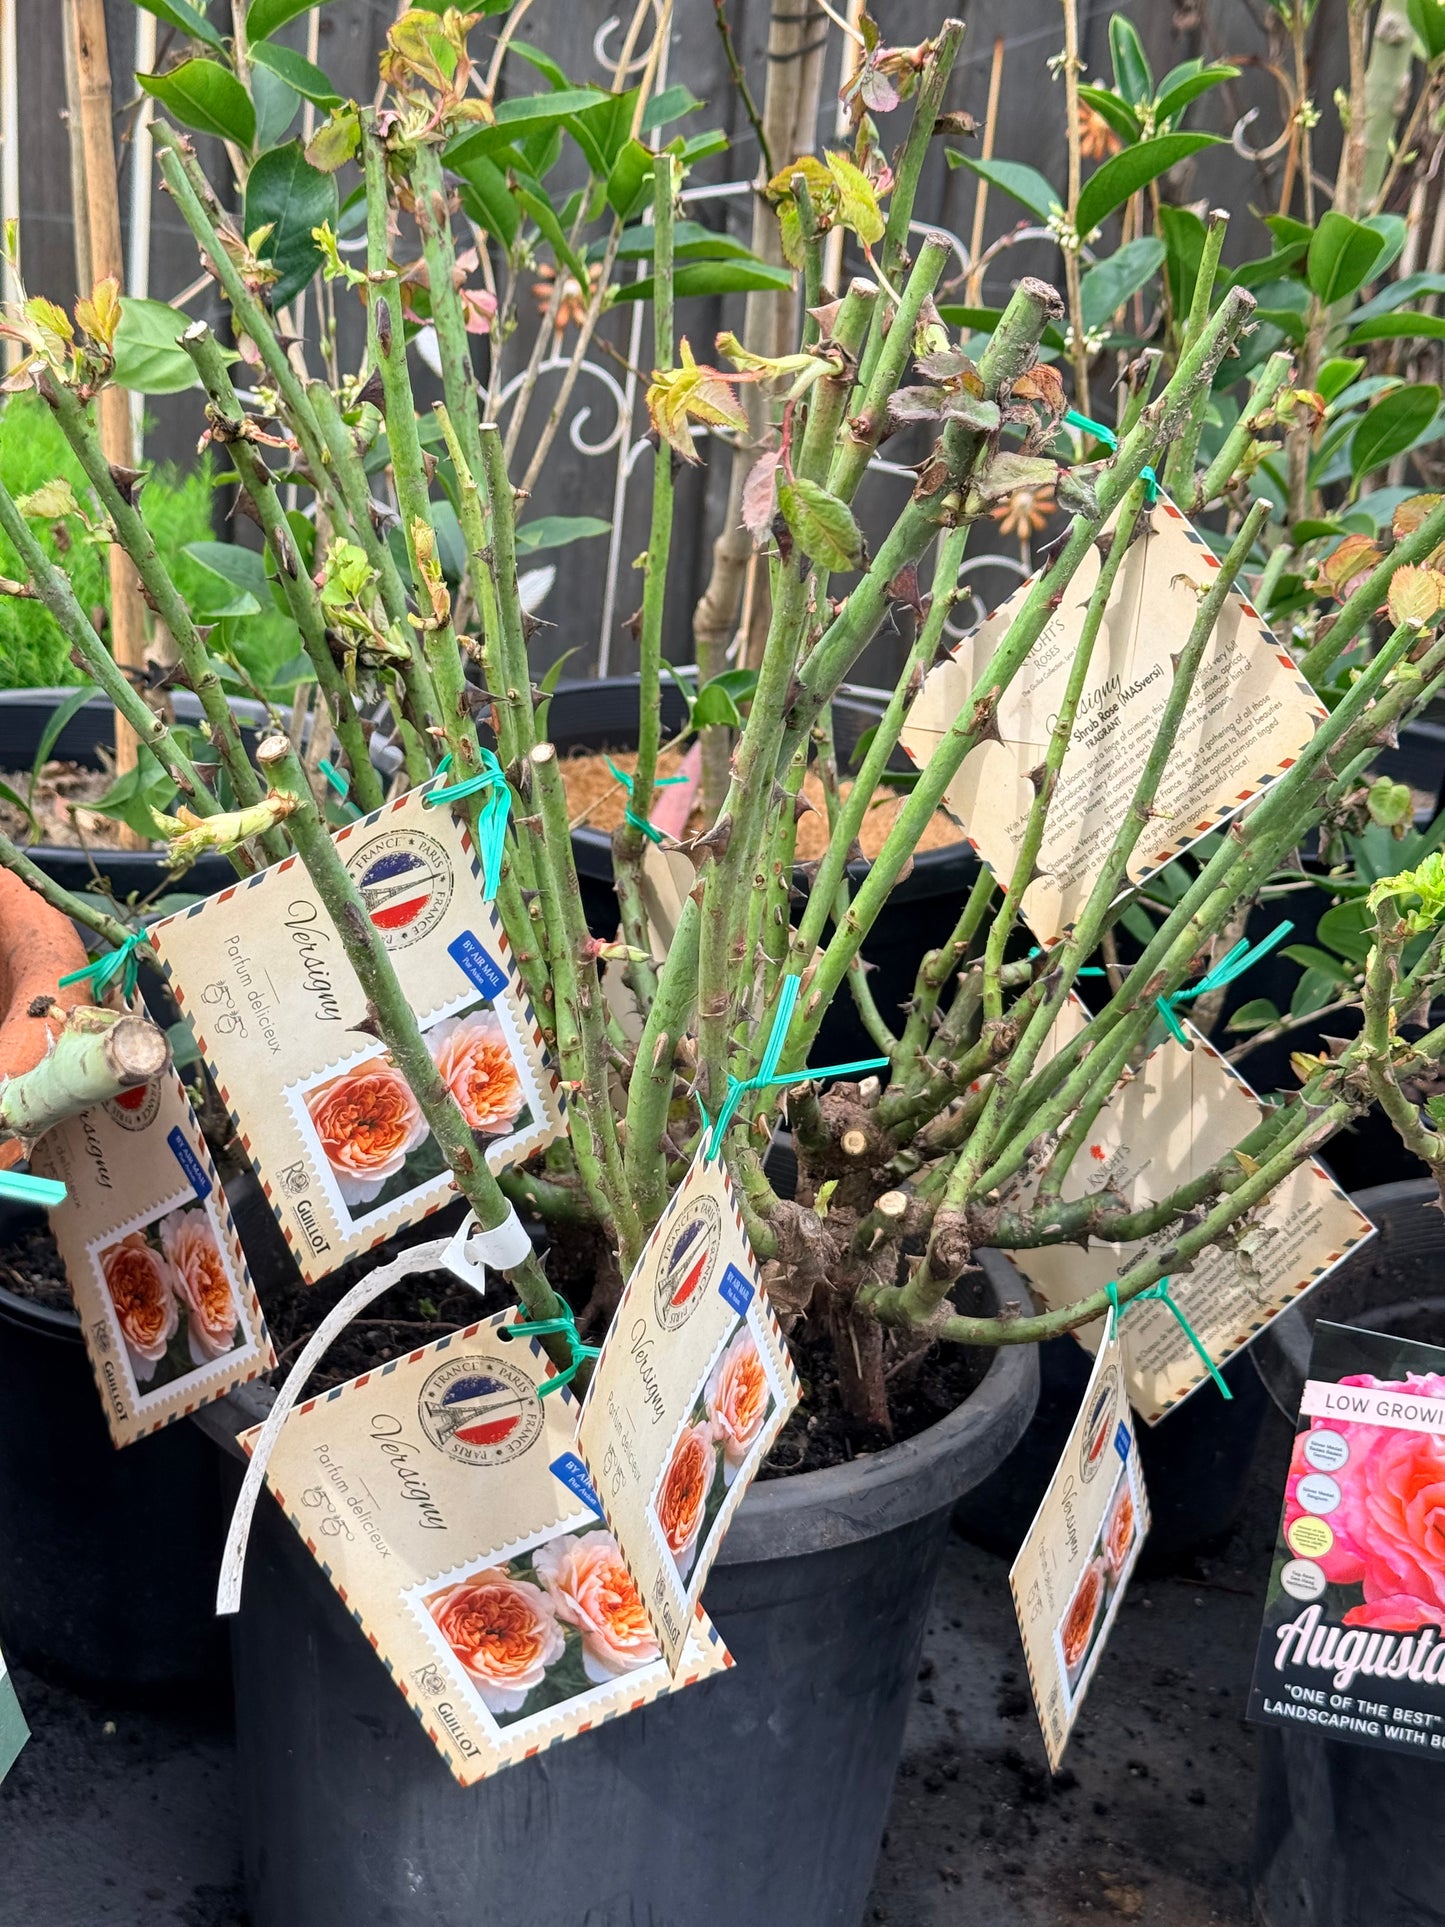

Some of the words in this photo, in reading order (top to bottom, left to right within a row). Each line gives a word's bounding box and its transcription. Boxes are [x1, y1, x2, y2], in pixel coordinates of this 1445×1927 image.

[1033, 644, 1060, 670] ROSES
[1062, 766, 1087, 786] blooms
[1085, 755, 1099, 769] and
[1097, 751, 1105, 759] a
[1102, 739, 1120, 754] tinge
[1119, 730, 1127, 742] of
[1126, 714, 1153, 736] crimson,
[1150, 702, 1164, 715] this
[1212, 650, 1228, 665] very
[1224, 639, 1238, 653] full
[1072, 718, 1099, 742] Shrub
[1096, 702, 1119, 722] Rose
[1116, 663, 1164, 706] (MASversi)
[1047, 803, 1059, 814] are
[1058, 779, 1087, 808] produced
[1084, 775, 1094, 783] in
[1092, 758, 1115, 778] clusters
[1113, 750, 1123, 761] of
[1120, 745, 1128, 754] 2
[1127, 740, 1136, 750] or
[1135, 728, 1153, 744] more.
[1192, 685, 1201, 697] of
[1201, 673, 1221, 690] anise,
[1219, 652, 1246, 675] apricot,
[1055, 808, 1069, 823] and
[1067, 794, 1088, 812] vanilla
[1092, 778, 1108, 792] very
[1106, 761, 1128, 781] distinct
[1125, 756, 1135, 765] in
[1134, 742, 1151, 759] each
[1196, 676, 1229, 709] occasional
[1228, 667, 1245, 681] hint
[1243, 659, 1252, 671] of
[1084, 715, 1121, 749] FRAGRANT
[1046, 827, 1066, 846] peach
[1083, 795, 1106, 814] flowers
[1103, 789, 1112, 797] in
[1111, 765, 1143, 792] continuous
[1195, 713, 1208, 725] the
[1207, 695, 1233, 716] season,
[1064, 852, 1088, 871] flowers
[1086, 841, 1101, 855] and
[1159, 779, 1183, 798] France.
[1184, 762, 1202, 778] Such
[1201, 742, 1229, 766] devotion
[1227, 736, 1237, 745] to
[1234, 719, 1254, 739] floral
[1251, 700, 1283, 725] beauties
[1070, 844, 1080, 854] de
[1077, 825, 1105, 847] Versigny
[1174, 756, 1192, 771] there
[1197, 745, 1205, 754] a
[1204, 722, 1236, 751] gathering
[1234, 712, 1243, 725] of
[1242, 705, 1253, 719] all
[1250, 694, 1270, 711] those
[1056, 874, 1076, 893] should
[1075, 863, 1091, 879] merit
[1159, 801, 1173, 812] this
[1172, 772, 1209, 804] semi-double
[1208, 753, 1233, 776] apricot
[1231, 735, 1257, 758] crimson
[1256, 716, 1279, 738] tinged
[1103, 792, 1129, 814] creating
[1127, 787, 1134, 795] a
[1141, 832, 1151, 841] to
[1150, 822, 1165, 837] give
[1180, 802, 1190, 811] to
[1188, 794, 1202, 806] this
[1199, 770, 1228, 797] beautiful
[1227, 754, 1250, 777] place!
[355, 836, 403, 869] FRANCE
[418, 841, 443, 868] PARIS
[1141, 837, 1165, 856] Height:
[1164, 820, 1187, 838] 120cm
[413, 892, 446, 934] FRANCE
[285, 899, 340, 1020] Versigny
[463, 940, 475, 952] BY
[471, 950, 485, 967] AIR
[481, 963, 500, 987] MAIL
[224, 934, 252, 987] Parfum
[247, 990, 280, 1054] delicieux
[1086, 1143, 1130, 1187] KNIGHT'S
[1109, 1165, 1127, 1180] OSES
[296, 1199, 330, 1253] GUILLOT
[103, 1360, 128, 1420] GUILLOT
[434, 1362, 480, 1388] FRANCE
[498, 1367, 530, 1393] PARIS
[630, 1318, 666, 1425] Versigny
[1325, 1394, 1370, 1413] LOW
[451, 1443, 487, 1460] PARIS
[510, 1414, 537, 1454] FRANCE
[370, 1413, 446, 1529] Versigny
[566, 1461, 579, 1473] BY
[313, 1443, 349, 1493] Parfum
[346, 1496, 390, 1558] delicieux
[1061, 1474, 1079, 1563] Versigny
[437, 1701, 481, 1757] GUILLOT
[1263, 1698, 1382, 1737] LANDSCAPING
[1384, 1724, 1427, 1745] WITH
[1329, 1694, 1353, 1710] OF
[1357, 1699, 1389, 1719] THE
